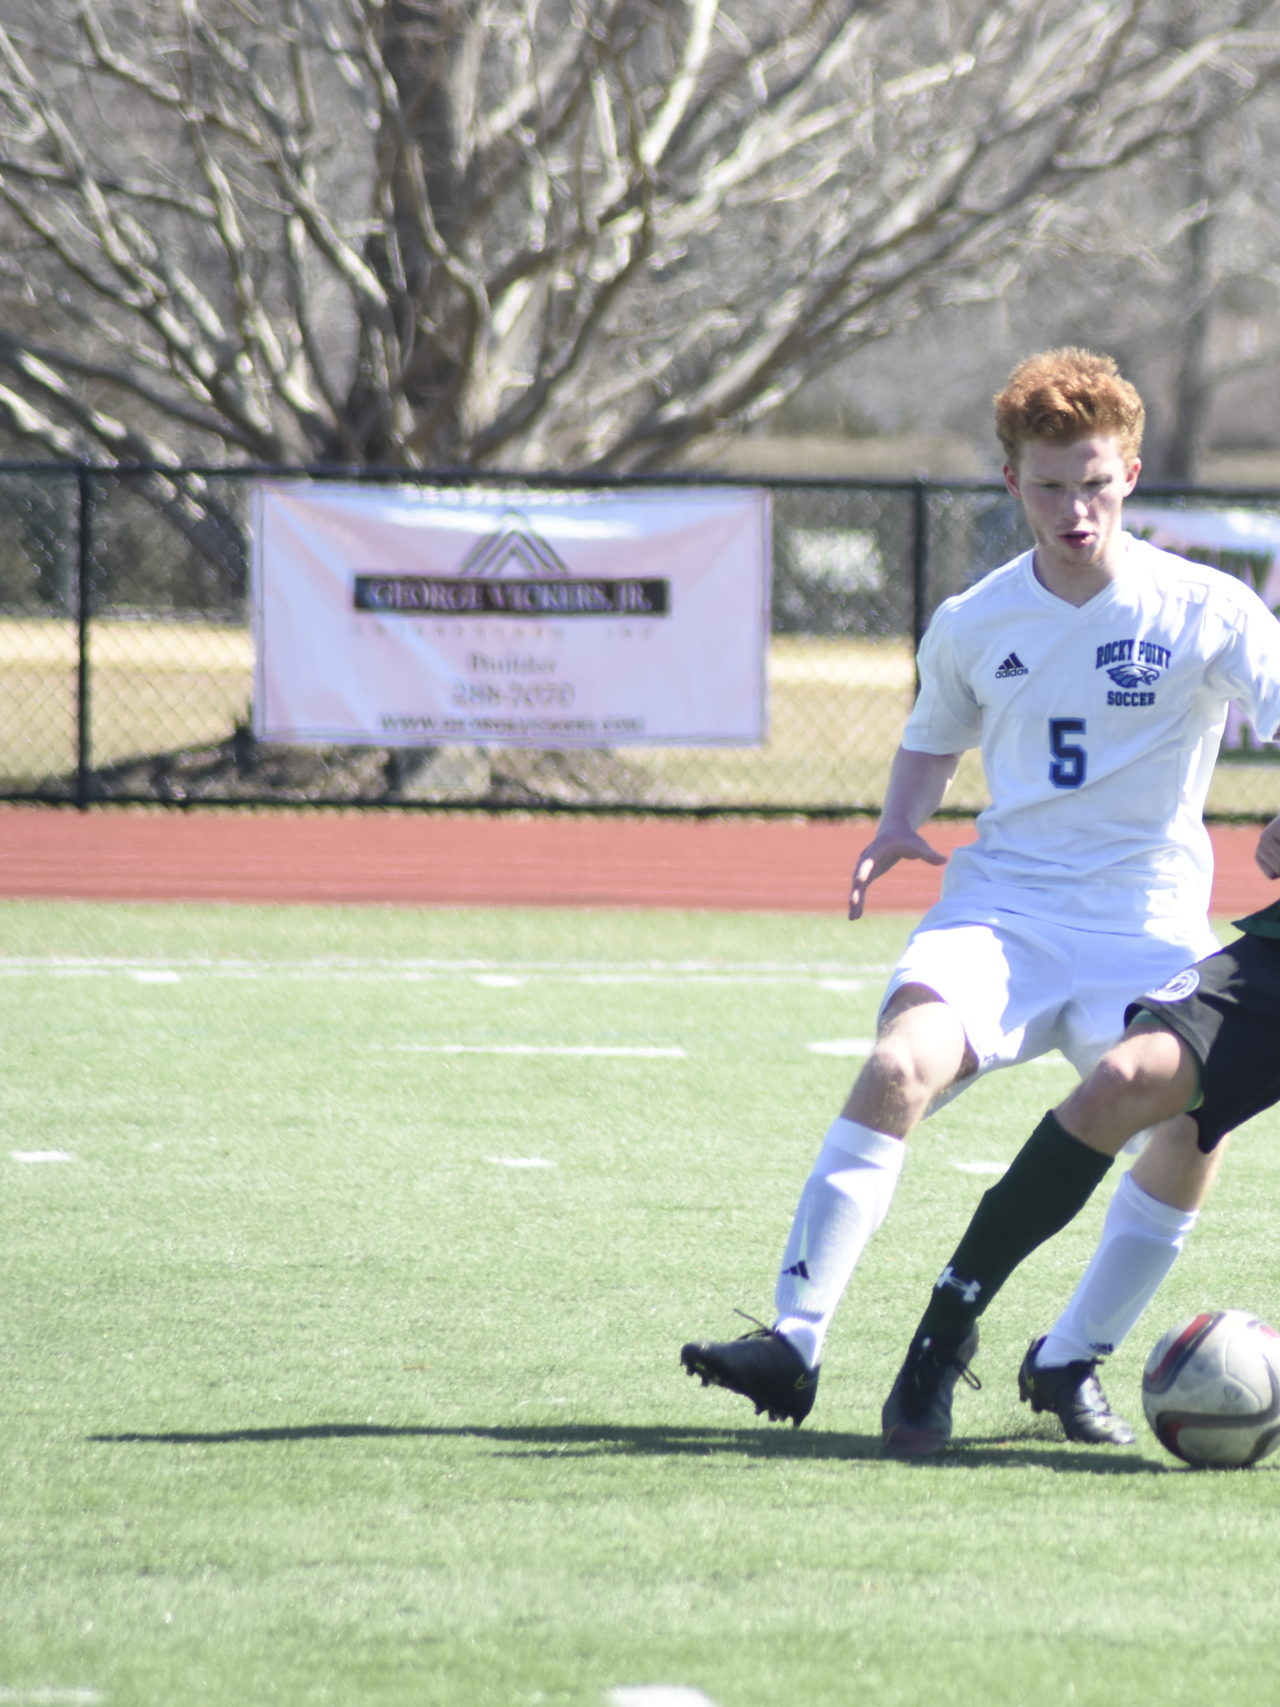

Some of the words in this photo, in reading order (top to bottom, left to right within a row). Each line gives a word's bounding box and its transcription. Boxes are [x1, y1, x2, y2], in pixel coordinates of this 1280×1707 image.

[369, 581, 484, 611] GEORGE
[1096, 639, 1135, 669] ROCKY
[1138, 640, 1172, 669] POINT
[995, 665, 1029, 679] adidas
[1107, 690, 1155, 706] SOCCER
[1049, 718, 1088, 789] 5
